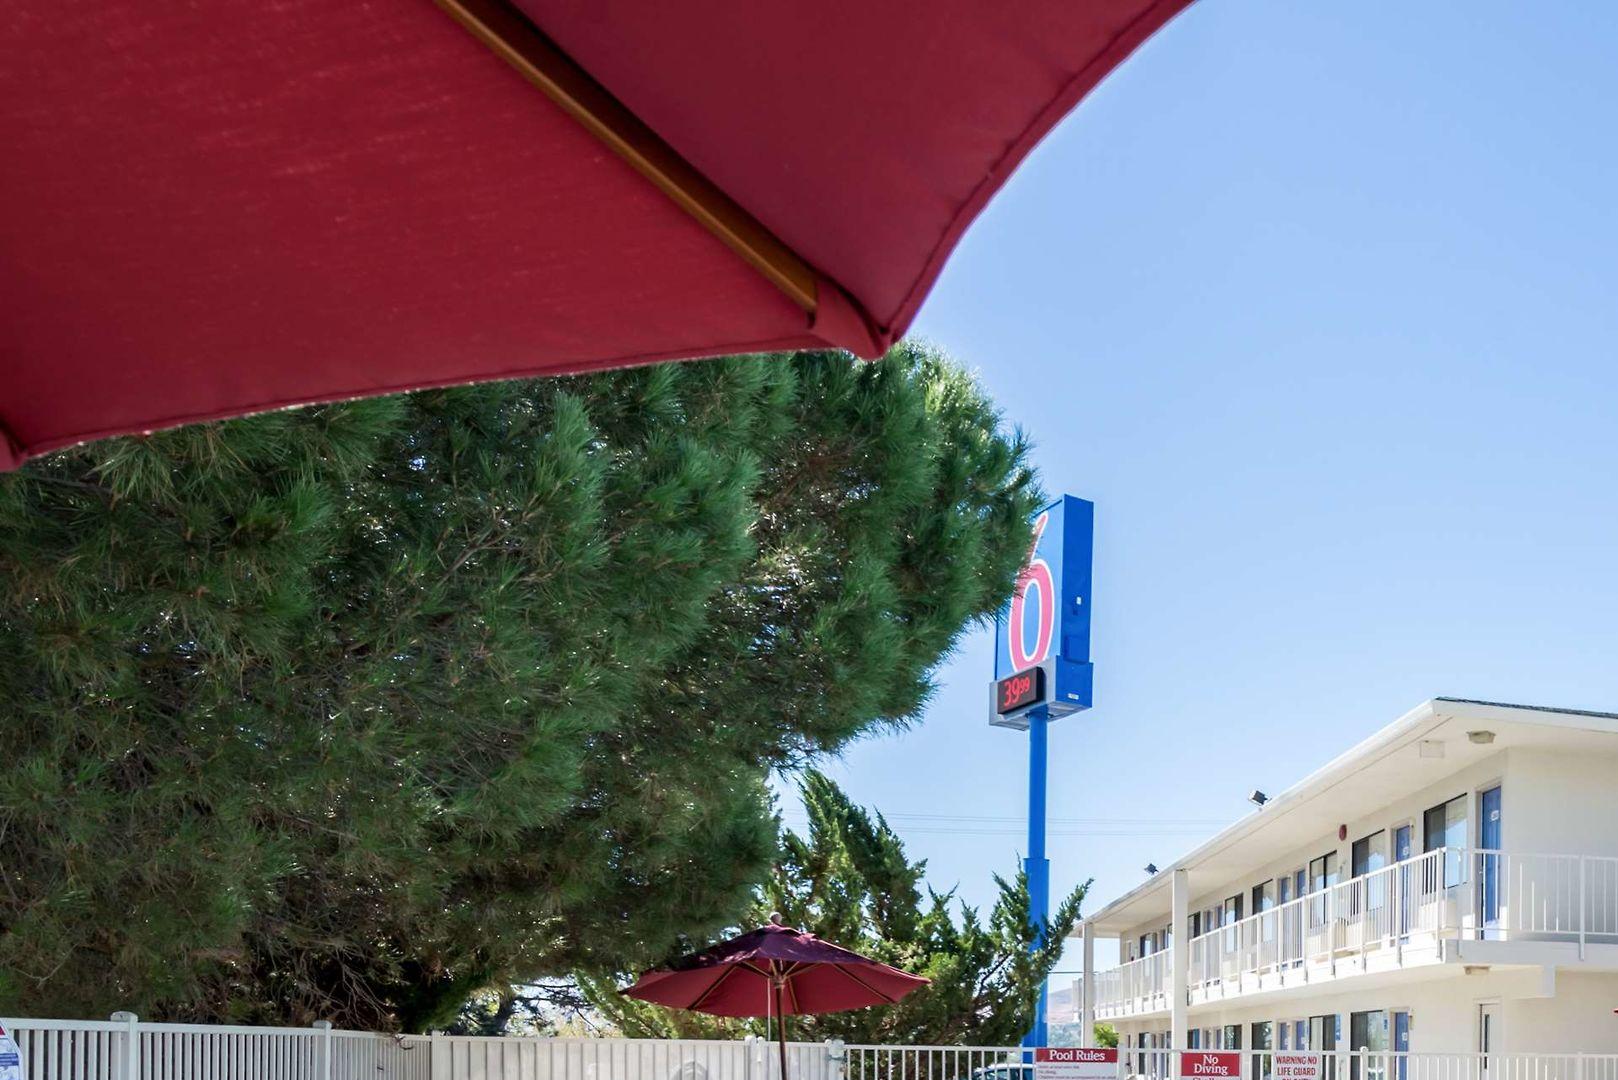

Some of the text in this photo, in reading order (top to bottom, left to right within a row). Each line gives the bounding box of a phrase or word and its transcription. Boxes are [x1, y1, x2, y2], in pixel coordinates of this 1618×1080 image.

[1009, 511, 1055, 672] 6
[1049, 1050, 1106, 1061] Pool Rules
[1203, 1054, 1219, 1065] No
[1275, 1056, 1318, 1065] WARNING NO
[1194, 1063, 1229, 1075] Diving
[1277, 1067, 1316, 1076] LIFE GUARD
